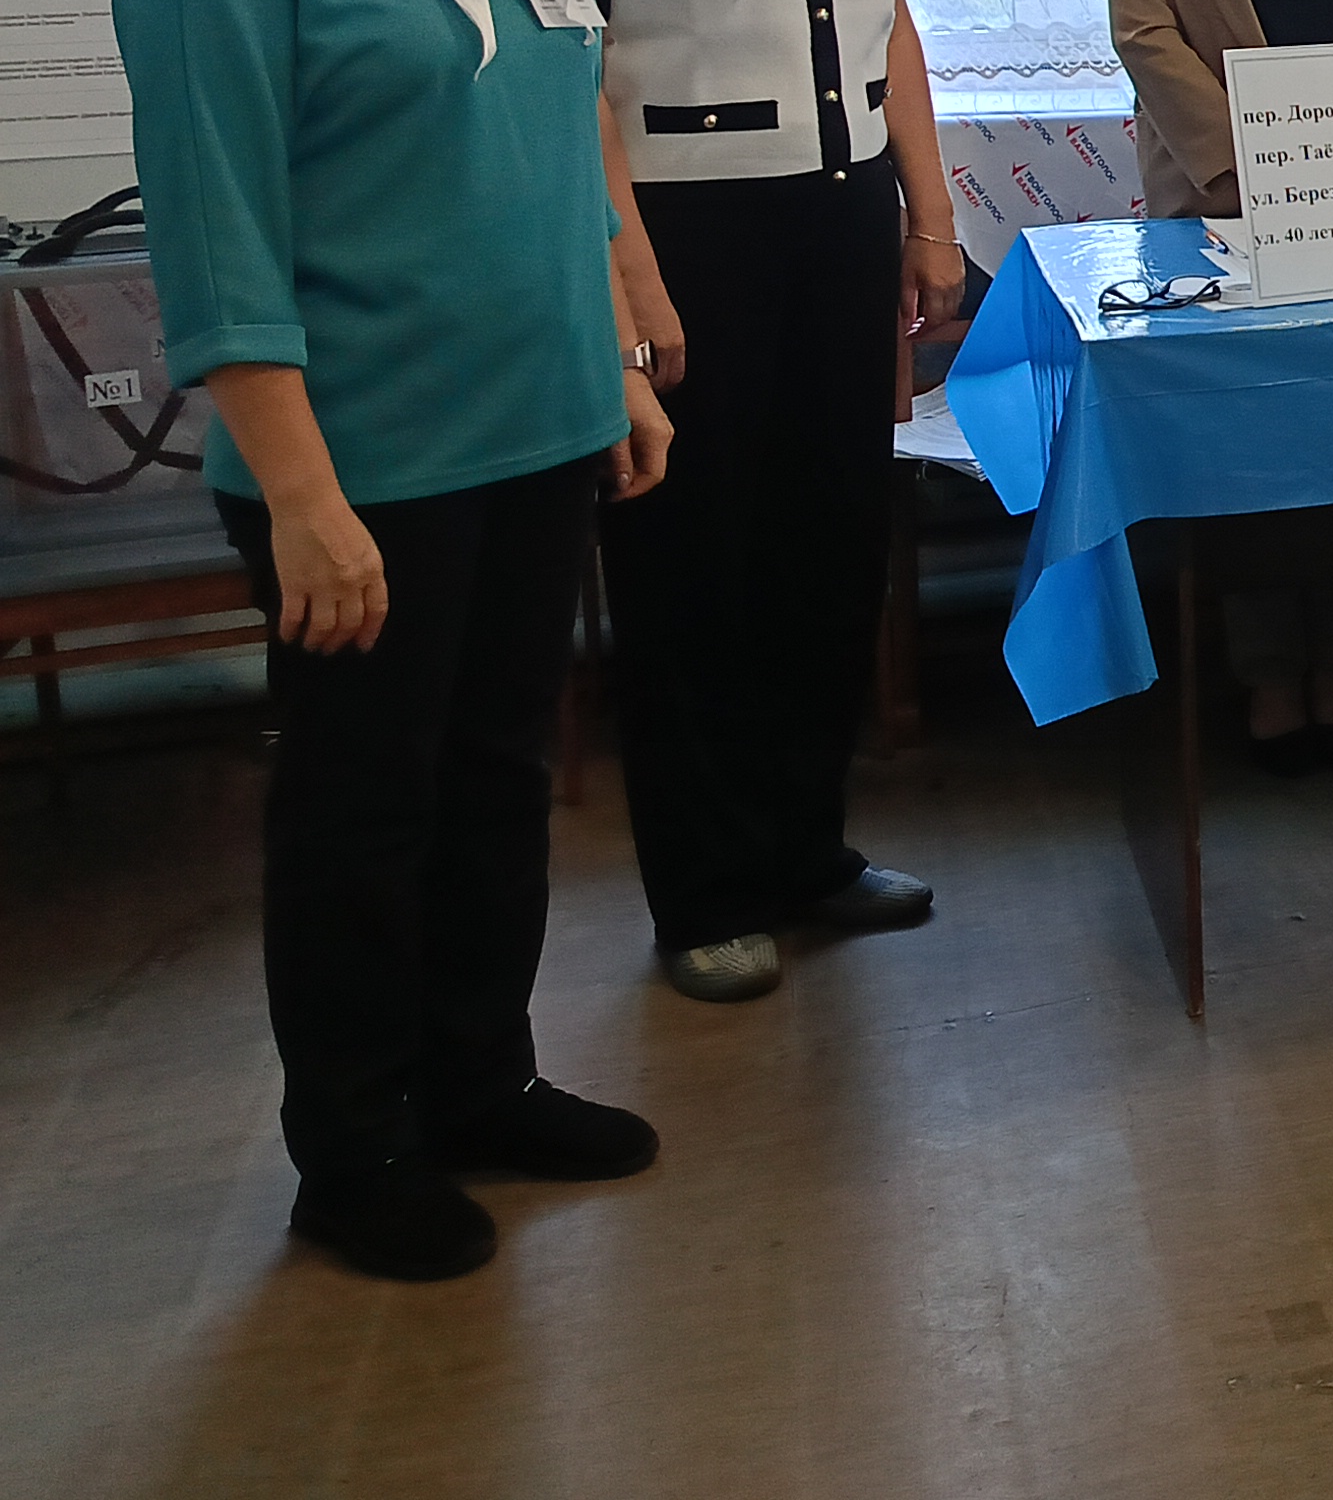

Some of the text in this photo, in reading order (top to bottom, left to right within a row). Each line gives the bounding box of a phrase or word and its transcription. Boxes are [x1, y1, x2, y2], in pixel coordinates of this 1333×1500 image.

[1243, 110, 1282, 127] пер.
[1069, 137, 1095, 168] ВАЖЕН
[1255, 150, 1294, 167] пер.
[1094, 154, 1117, 184] ГОЛОС
[955, 177, 981, 209] ВАЖЕН
[1015, 176, 1040, 207] ВАЖЕН
[1250, 193, 1279, 210] ул.
[981, 195, 1005, 225] ГОЛОС
[1040, 193, 1064, 223] ГОЛОС
[1254, 234, 1280, 250] ул.
[1284, 228, 1303, 243] 40
